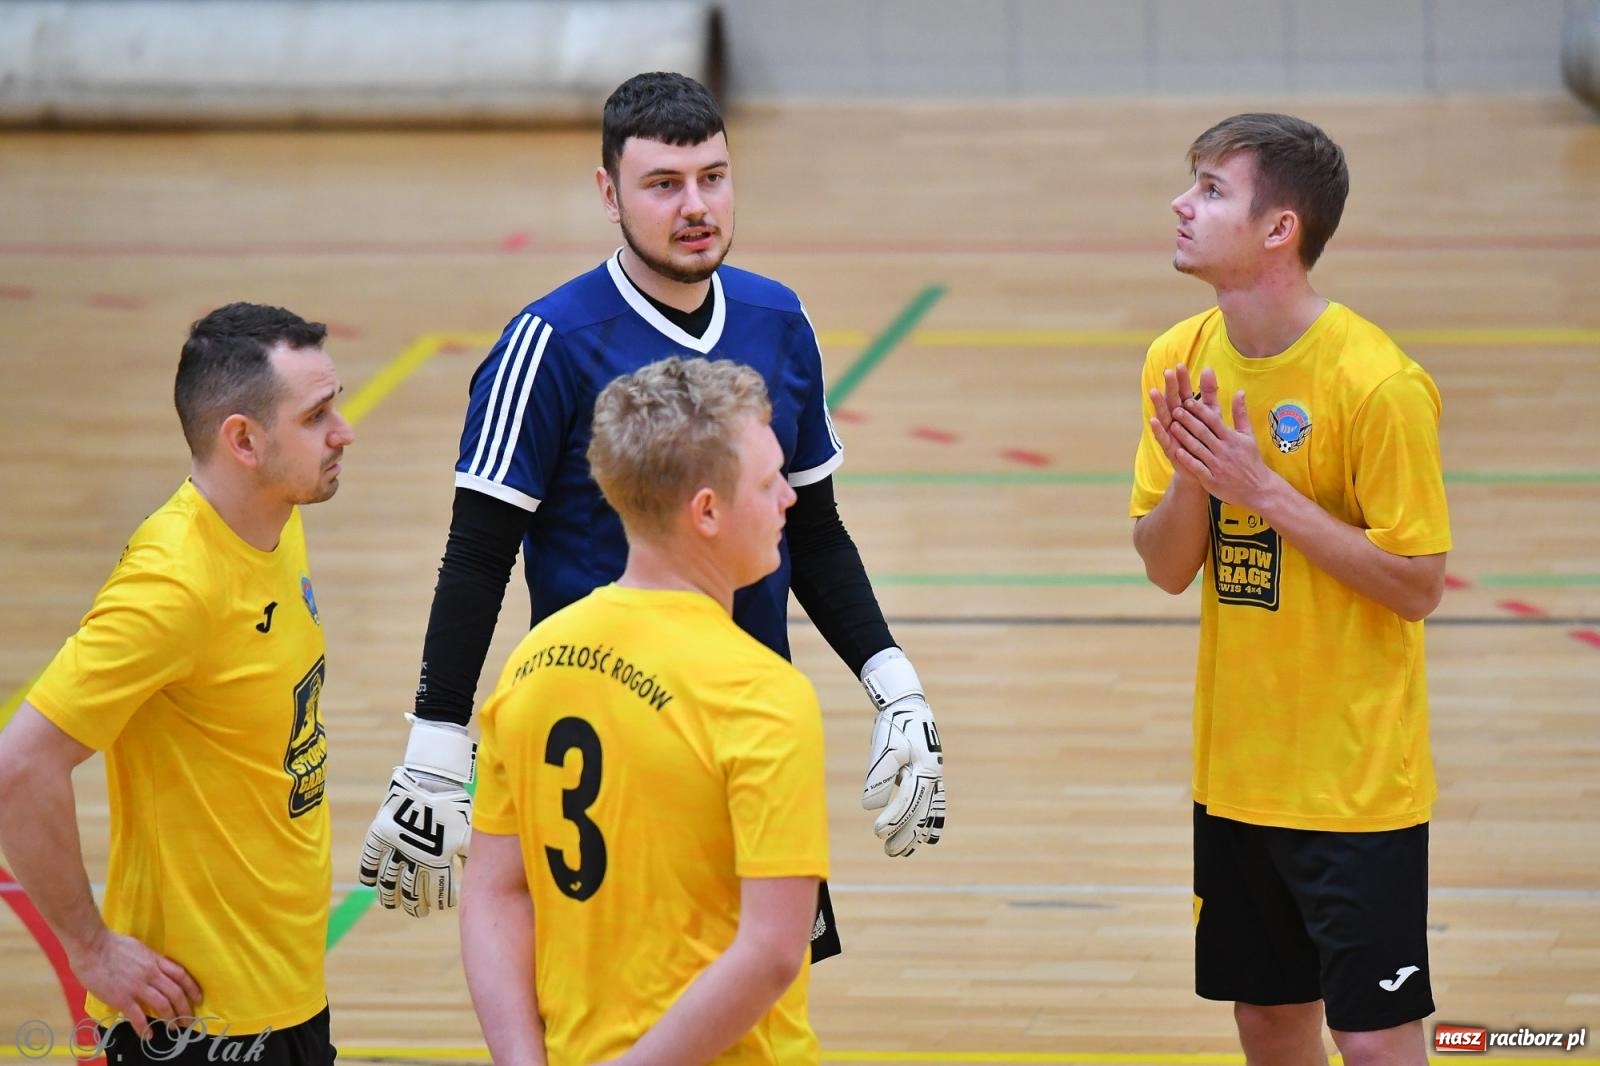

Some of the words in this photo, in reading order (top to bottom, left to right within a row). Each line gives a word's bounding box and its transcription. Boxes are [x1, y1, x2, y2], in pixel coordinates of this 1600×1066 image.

[1219, 546, 1272, 569] OPIW
[1218, 583, 1241, 593] WIS
[1219, 566, 1272, 589] RAGE
[512, 644, 613, 687] PRZYSZŁOŚĆ
[611, 657, 673, 712] ROGÓW
[545, 716, 607, 903] 3
